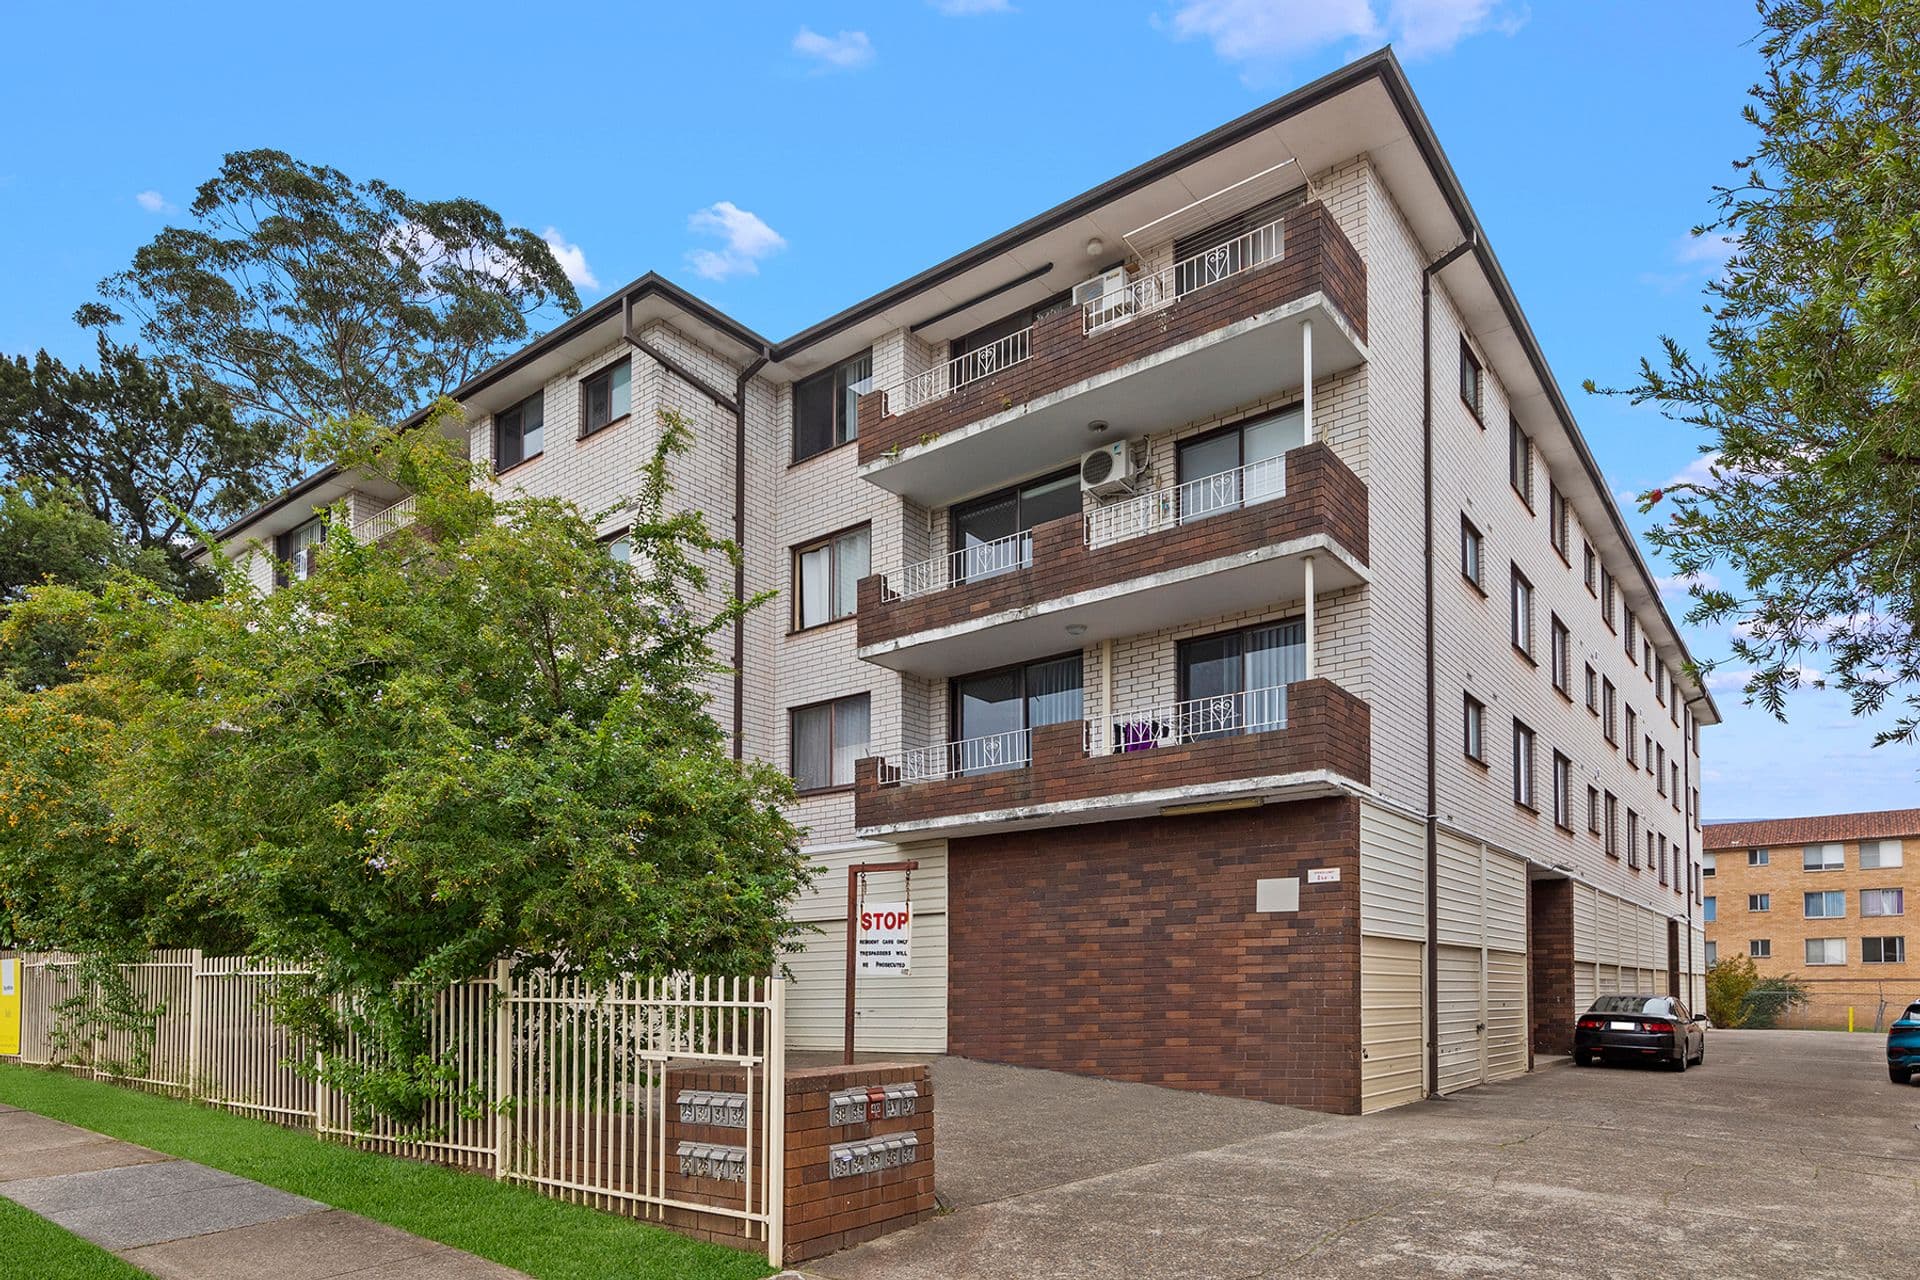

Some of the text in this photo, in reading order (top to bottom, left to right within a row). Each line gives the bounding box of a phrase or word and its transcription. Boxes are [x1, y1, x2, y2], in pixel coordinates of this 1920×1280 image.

[861, 911, 908, 931] STOP
[875, 960, 906, 968] PROSECUTED
[732, 1109, 744, 1121] 32
[733, 1161, 745, 1174] 28
